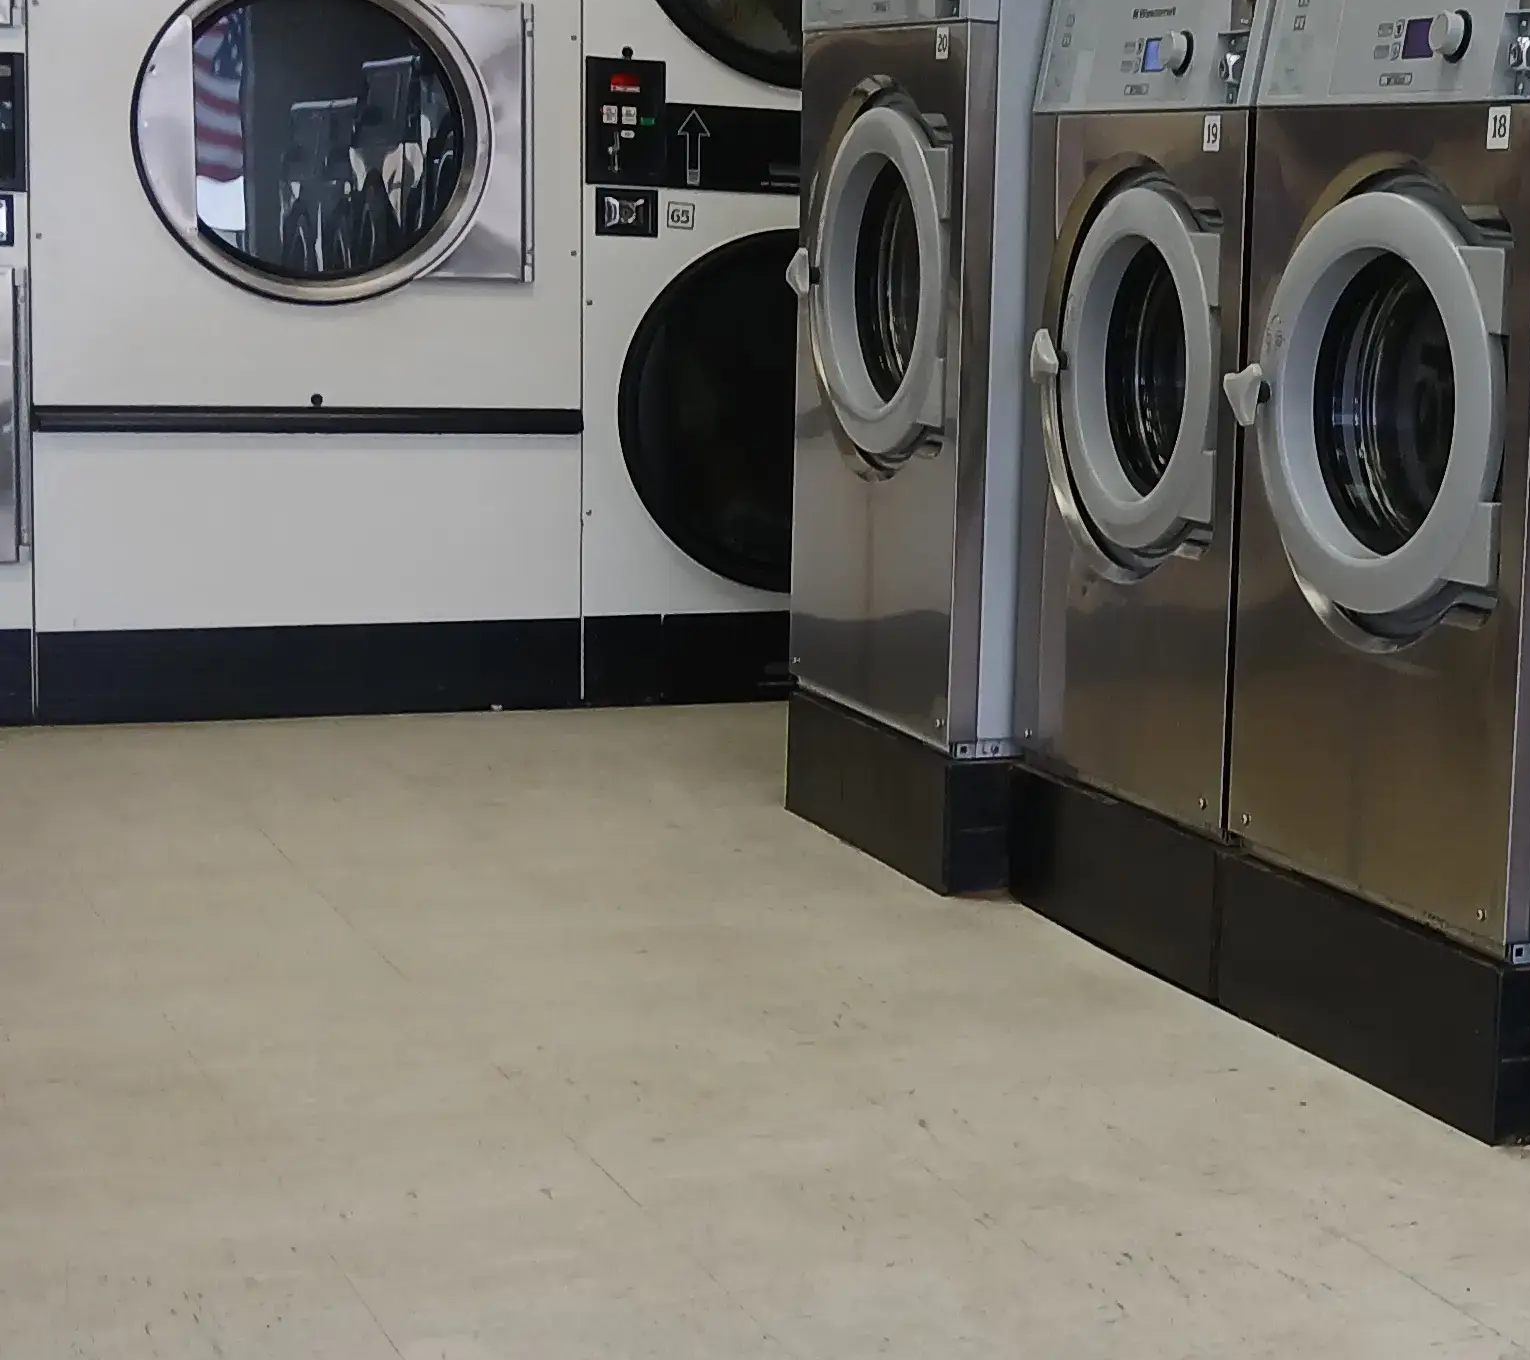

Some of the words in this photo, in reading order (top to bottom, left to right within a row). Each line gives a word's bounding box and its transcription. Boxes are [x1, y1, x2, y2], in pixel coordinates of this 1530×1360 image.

[937, 34, 947, 53] 20
[1207, 123, 1218, 144] 19
[1492, 114, 1507, 139] 18
[670, 209, 690, 224] 65
